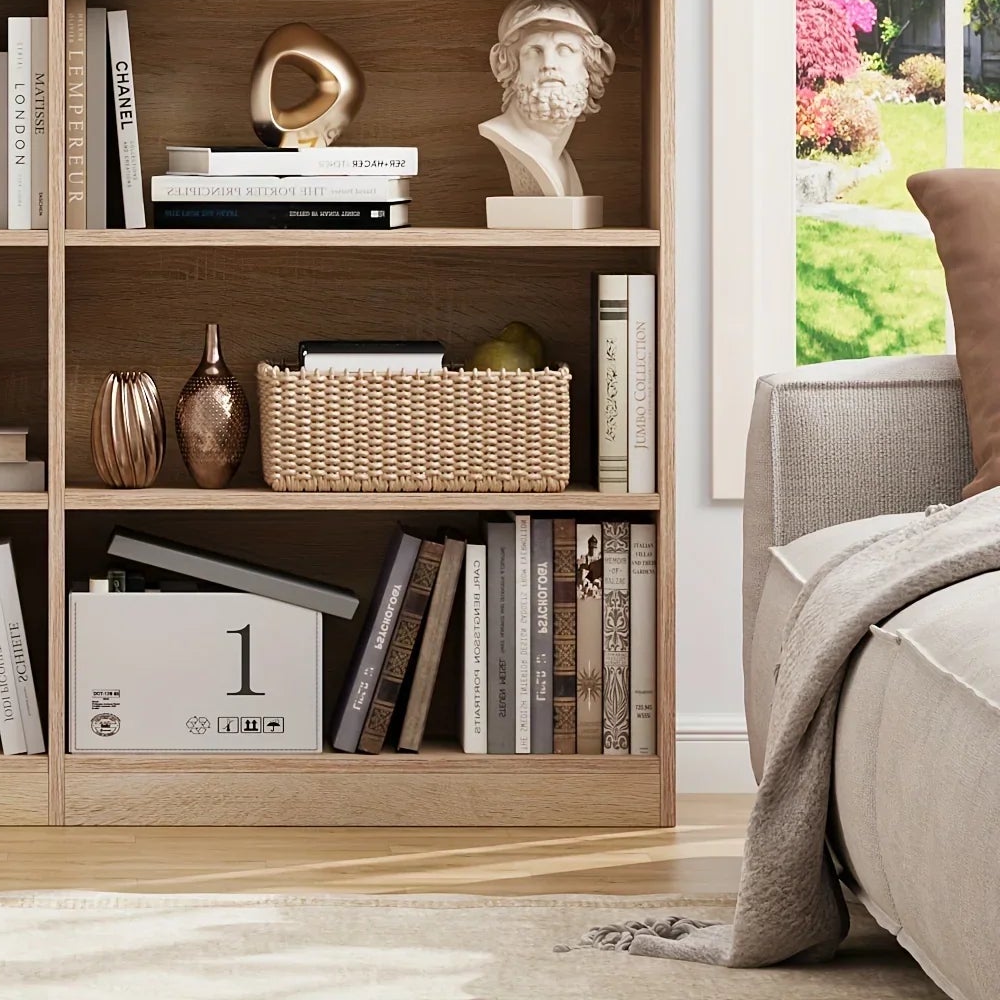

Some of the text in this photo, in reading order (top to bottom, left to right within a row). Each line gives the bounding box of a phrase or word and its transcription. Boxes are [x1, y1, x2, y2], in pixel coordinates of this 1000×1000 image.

[14, 83, 26, 165] LONDON
[34, 72, 45, 135] MATISSE
[67, 50, 84, 203] LEMPEREUR
[115, 60, 133, 131] CHANEL
[634, 406, 649, 449] JUMBO
[226, 623, 266, 696] 1
